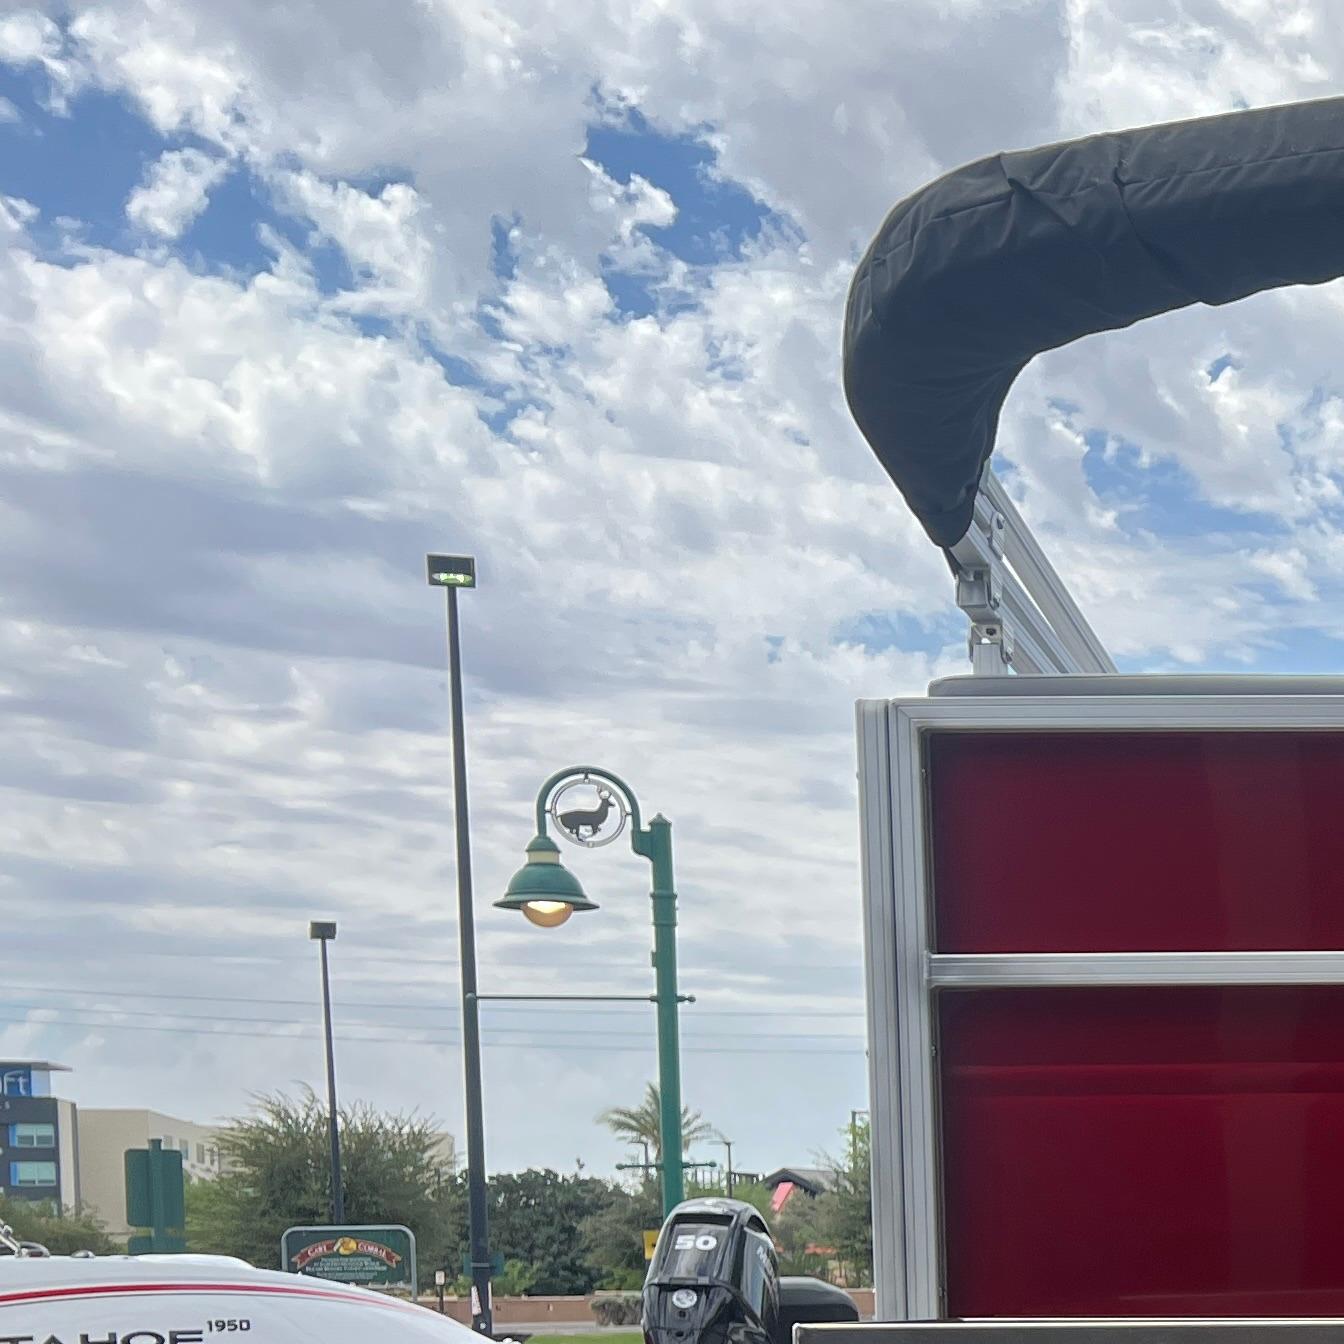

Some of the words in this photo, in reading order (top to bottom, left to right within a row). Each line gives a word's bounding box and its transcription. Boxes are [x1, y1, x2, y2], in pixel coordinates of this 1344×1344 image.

[0, 1070, 29, 1096] ft
[674, 1234, 718, 1251] 50
[206, 1319, 251, 1333] 1950
